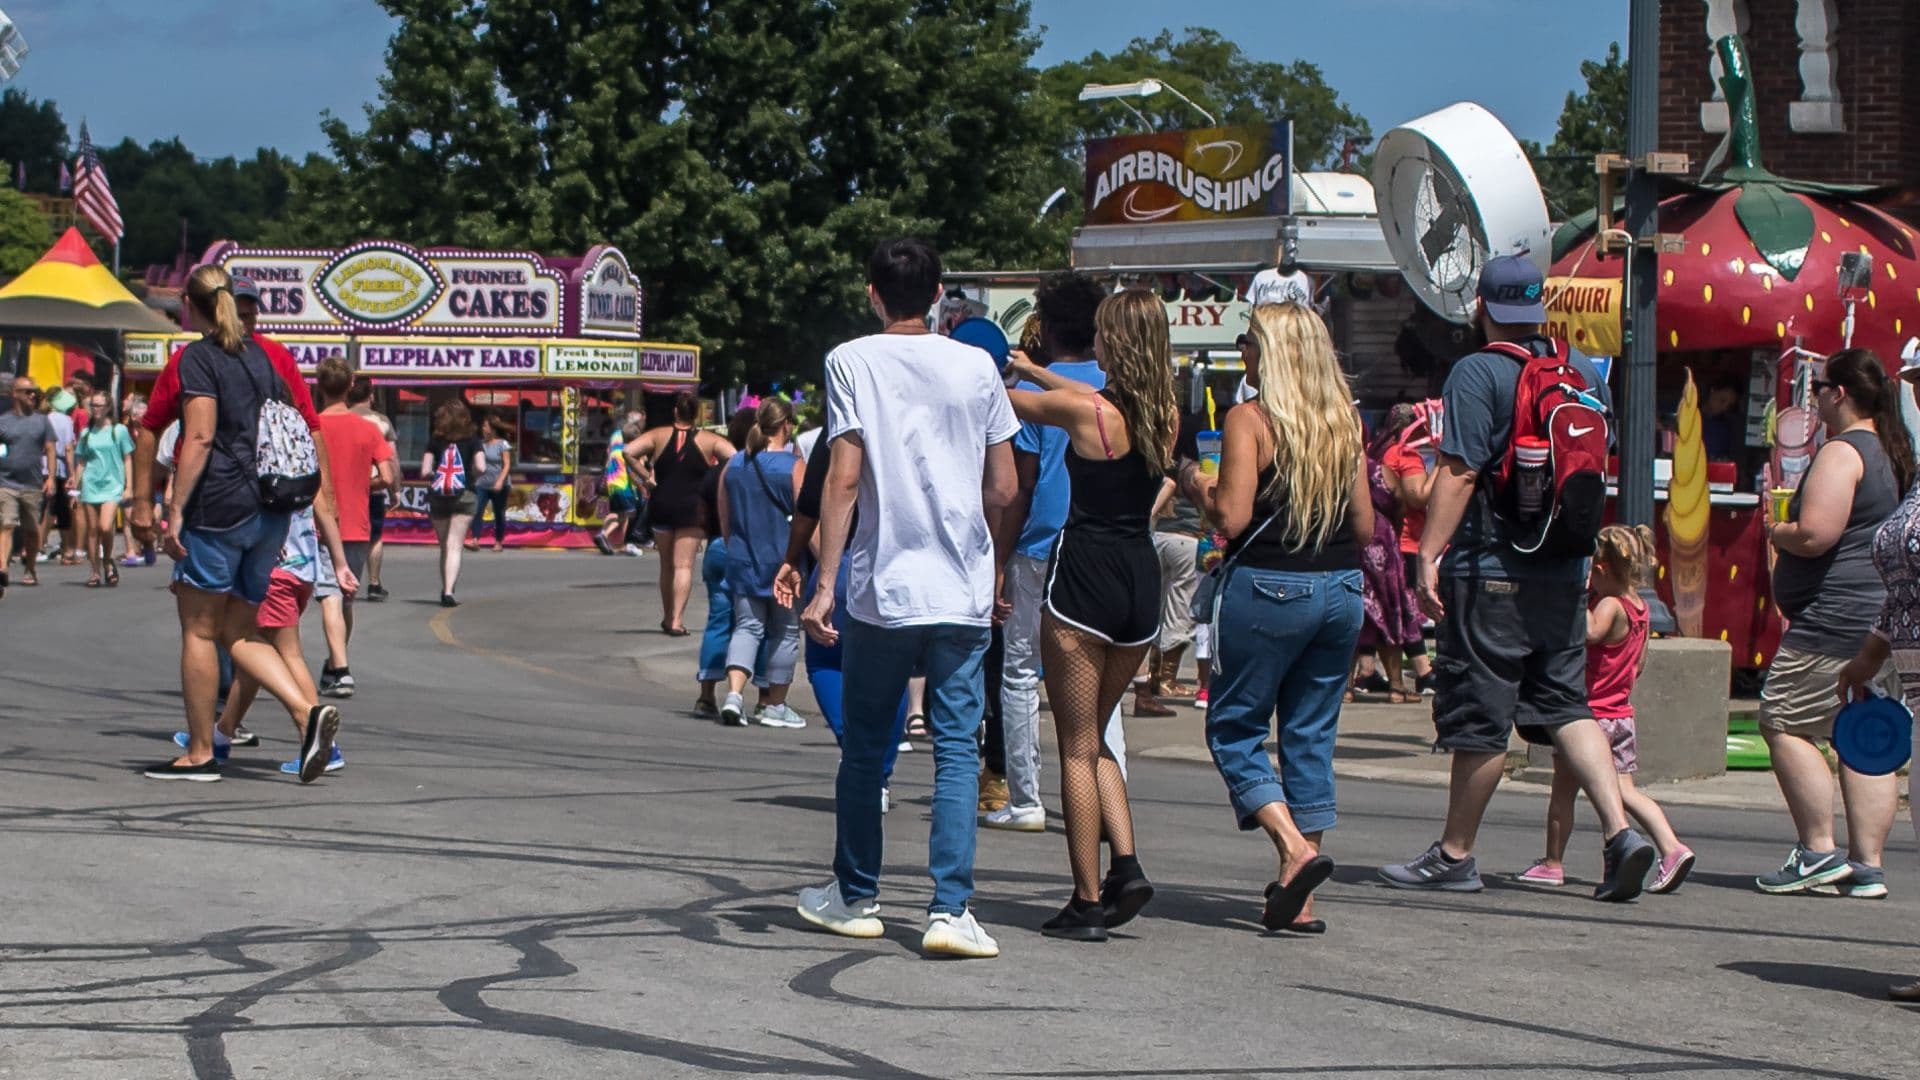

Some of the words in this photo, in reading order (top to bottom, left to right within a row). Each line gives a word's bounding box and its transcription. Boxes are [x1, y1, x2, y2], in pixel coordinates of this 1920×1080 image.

[1092, 150, 1283, 211] AIRBRUSHING
[231, 267, 304, 282] FUNNEL
[451, 268, 527, 285] FUNNEL
[448, 288, 548, 319] CAKES
[365, 347, 475, 367] ELEPHANT
[480, 349, 536, 368] EARS
[555, 348, 588, 358] Fresh
[555, 360, 635, 373] LEMONADE
